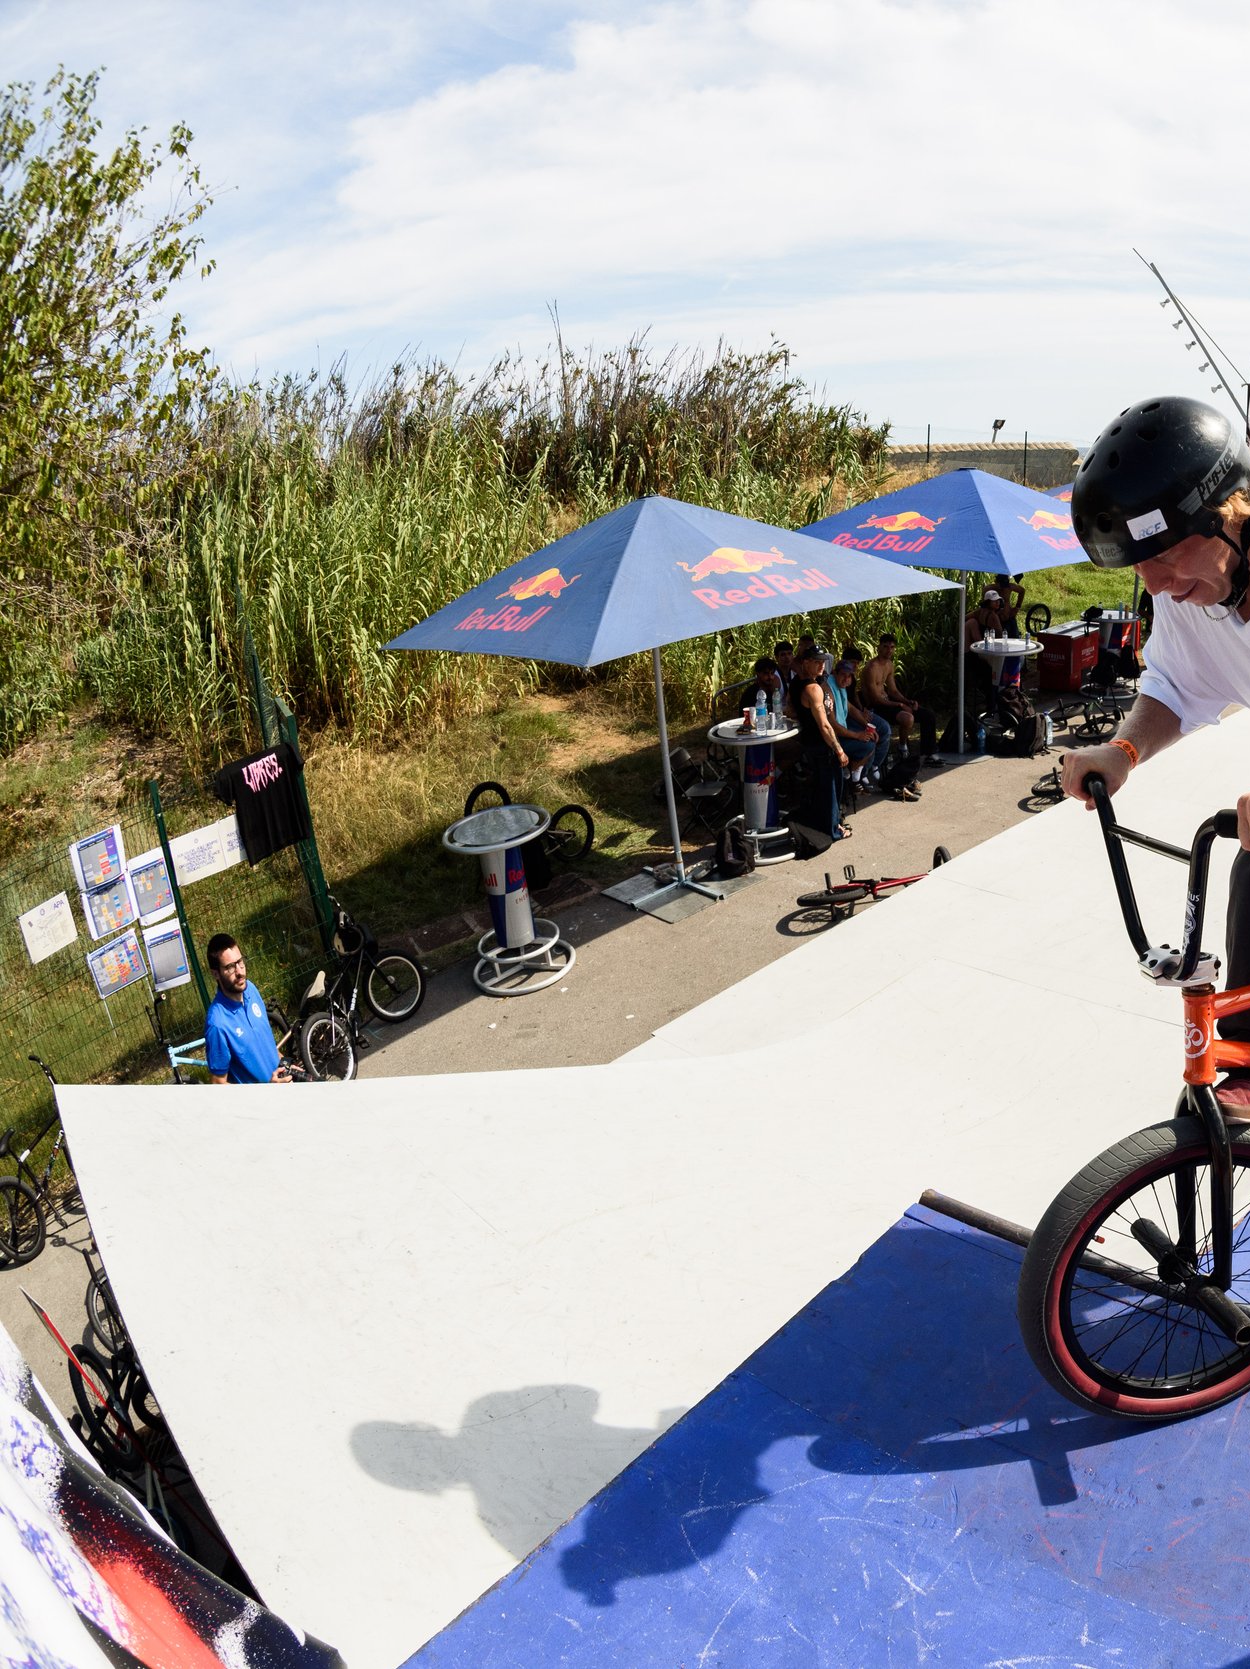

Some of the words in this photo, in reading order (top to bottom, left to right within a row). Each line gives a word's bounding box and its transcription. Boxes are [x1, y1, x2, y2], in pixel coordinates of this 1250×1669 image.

[1138, 522, 1162, 539] RCF
[831, 533, 884, 550] Red
[872, 535, 935, 553] Bull
[690, 576, 777, 610] Red
[766, 568, 839, 595] Bull
[453, 605, 501, 632] Red
[487, 606, 553, 633] Bull
